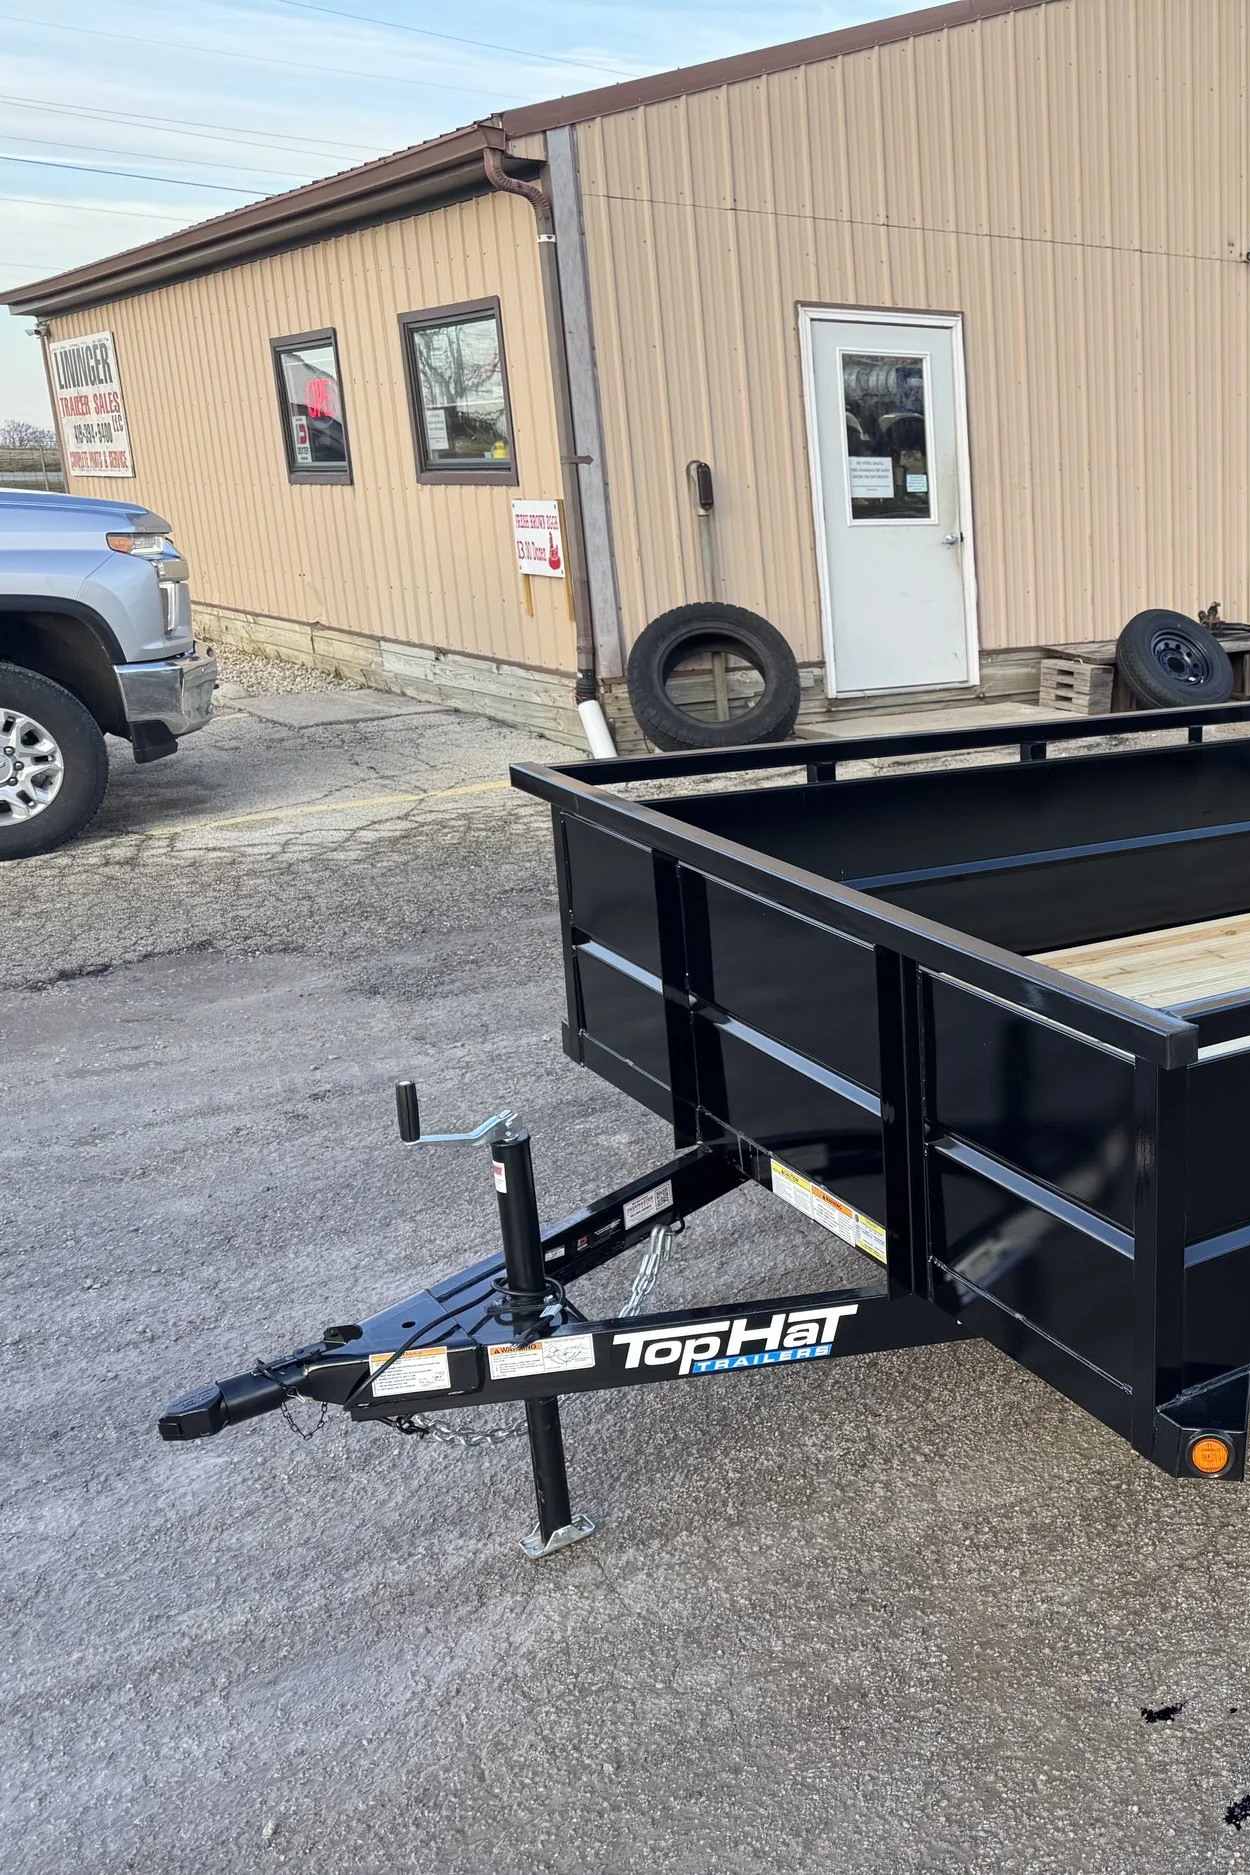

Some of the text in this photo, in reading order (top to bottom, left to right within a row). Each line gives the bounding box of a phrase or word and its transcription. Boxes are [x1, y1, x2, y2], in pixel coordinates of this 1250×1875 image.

[53, 343, 113, 389] LININGER
[60, 391, 120, 416] TRAILER SALES
[694, 1345, 831, 1370] TRAILERS
